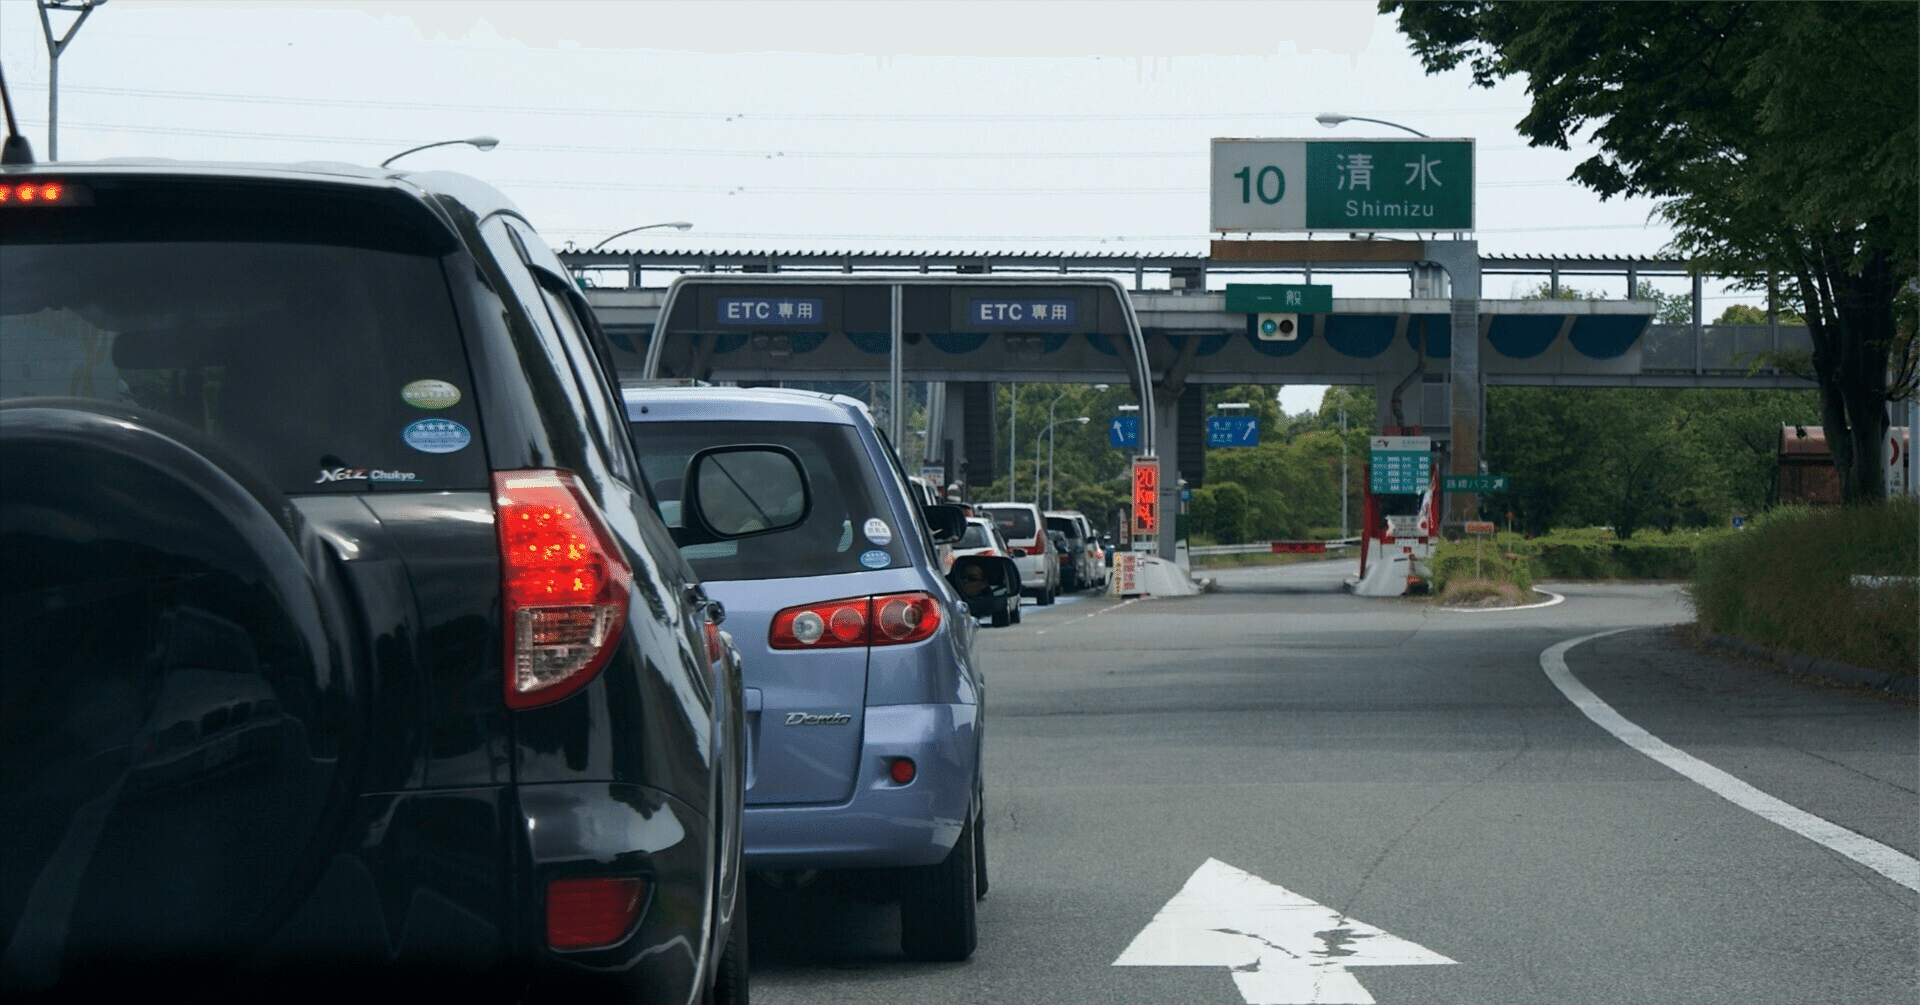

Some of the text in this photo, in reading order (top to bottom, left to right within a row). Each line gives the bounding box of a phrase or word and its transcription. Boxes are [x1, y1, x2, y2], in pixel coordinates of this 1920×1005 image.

[1337, 153, 1442, 191] 清水
[1233, 165, 1286, 204] 10
[1345, 199, 1434, 217] Shimizu
[1257, 289, 1301, 306] 一般
[728, 302, 813, 319] ETC 専用
[981, 303, 1067, 321] ETC 専用
[370, 469, 416, 482] Chukyo
[785, 712, 852, 725] Demio
